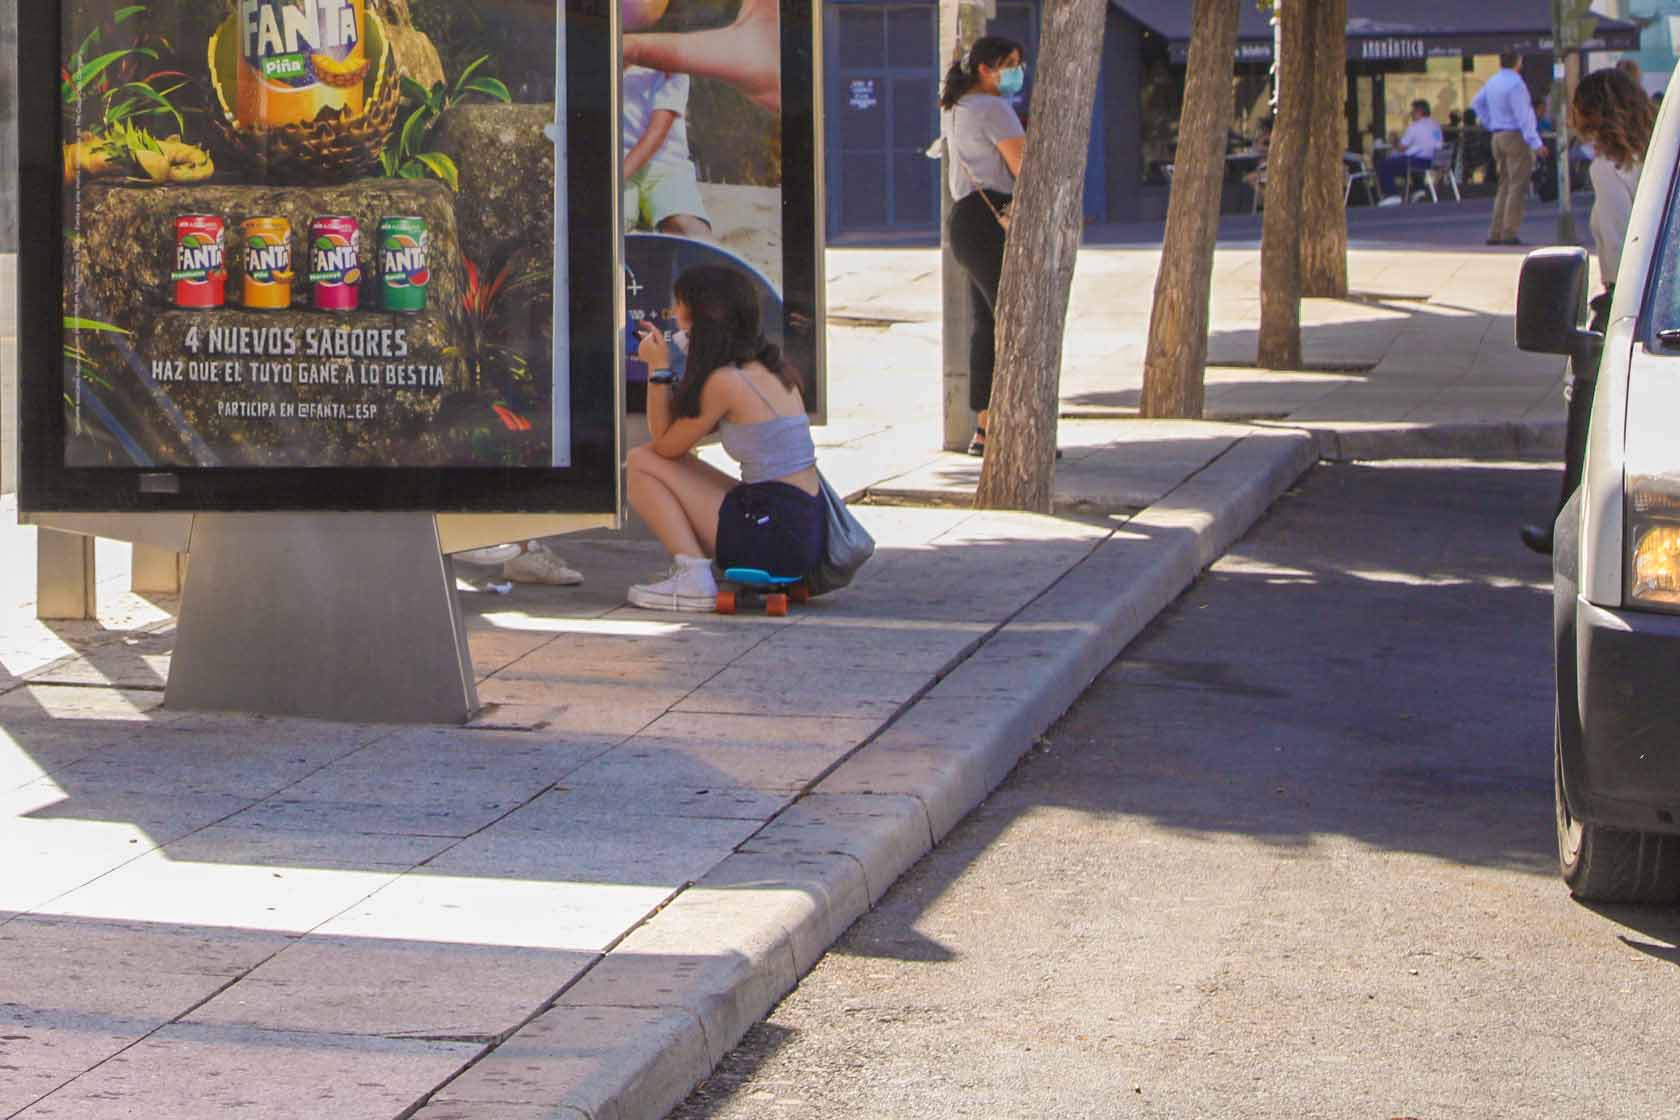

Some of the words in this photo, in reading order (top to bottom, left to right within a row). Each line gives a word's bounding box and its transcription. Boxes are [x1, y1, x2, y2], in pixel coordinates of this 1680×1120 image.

[266, 57, 302, 76] Piña
[184, 327, 199, 353] 4
[208, 327, 297, 355] NUEVOS
[306, 328, 409, 357] SABORES
[151, 360, 183, 381] HAZ
[188, 361, 219, 381] QUE
[225, 361, 242, 382] EL
[249, 362, 292, 384] TUYO
[298, 362, 339, 384] GANE
[345, 363, 355, 384] A
[360, 364, 380, 385] LO
[385, 364, 444, 387] BESTIA
[218, 401, 276, 418] PARTICIPA
[280, 402, 294, 417] EN
[298, 403, 377, 419] @FANTA_ESP
